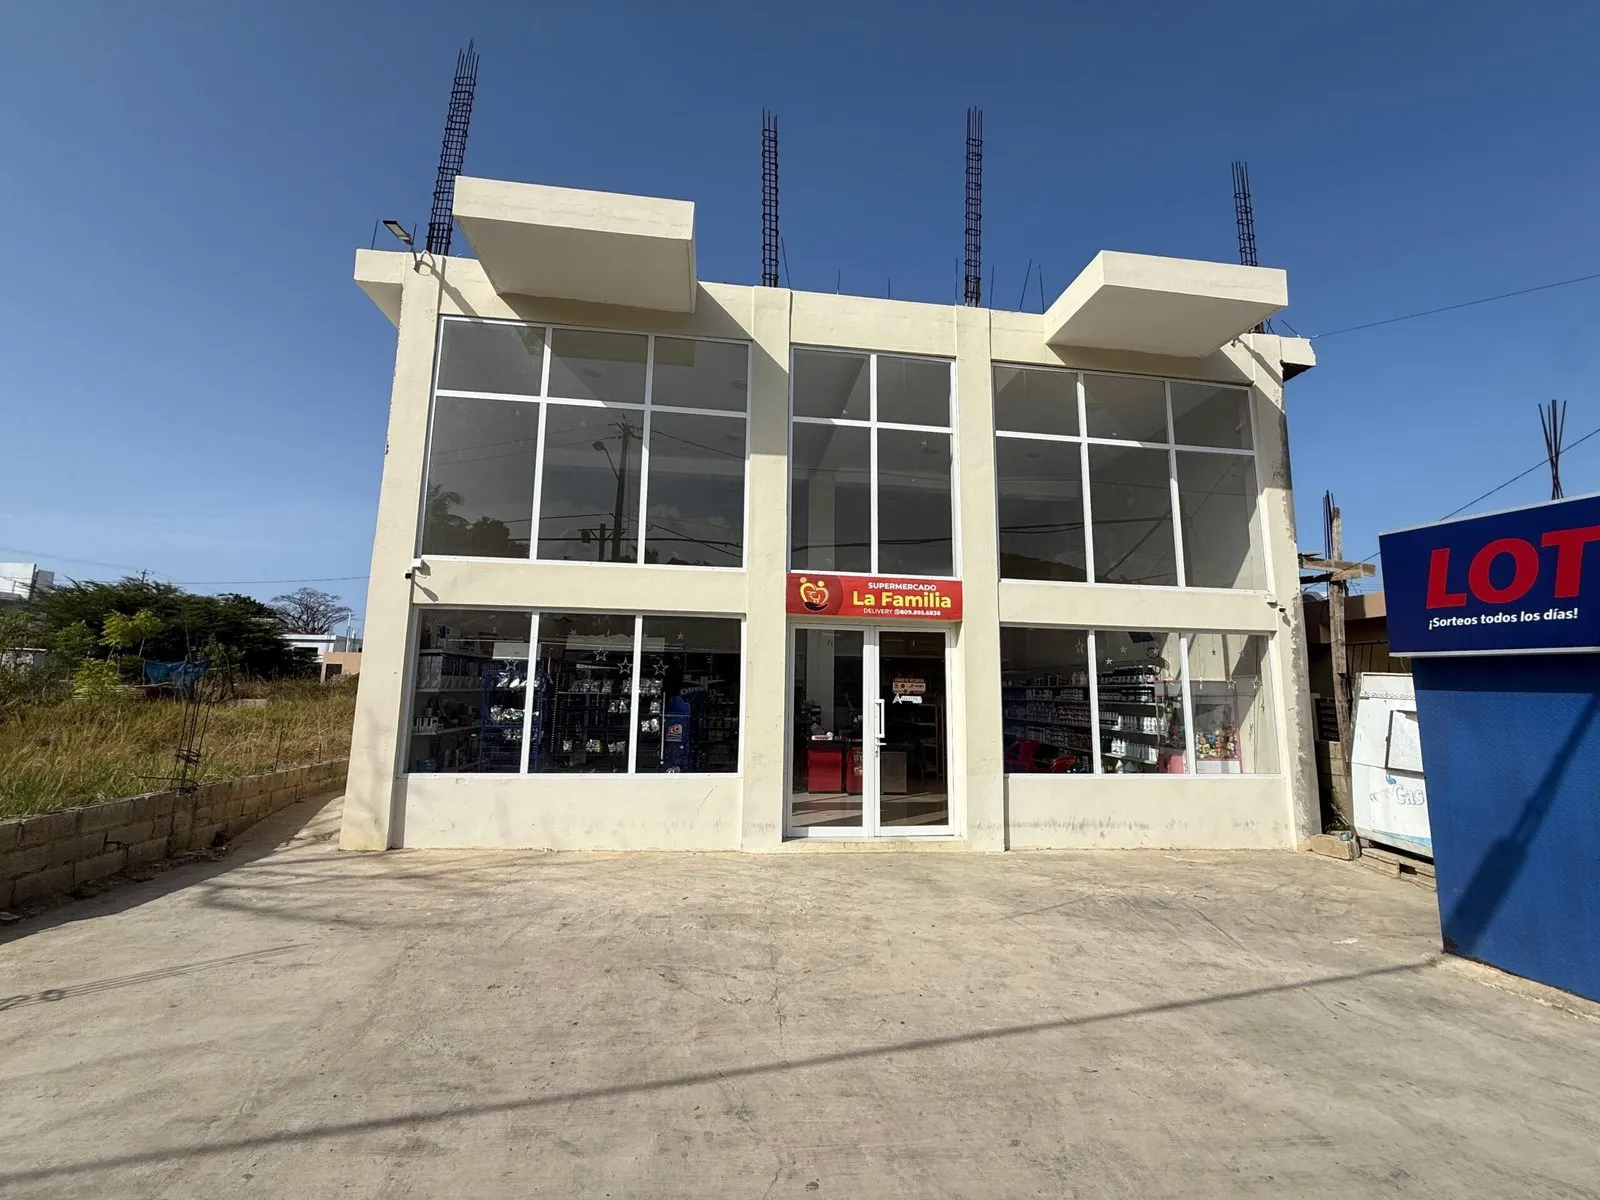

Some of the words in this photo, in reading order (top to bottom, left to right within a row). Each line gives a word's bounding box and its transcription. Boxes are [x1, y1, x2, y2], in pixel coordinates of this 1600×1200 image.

[867, 582, 937, 591] SUPERMERCADO
[853, 590, 875, 606] La
[881, 592, 952, 609] Familia
[1428, 616, 1478, 630] ¡Sorteos
[1480, 613, 1518, 625] todos
[1520, 611, 1540, 622] los
[1543, 608, 1579, 620] días!
